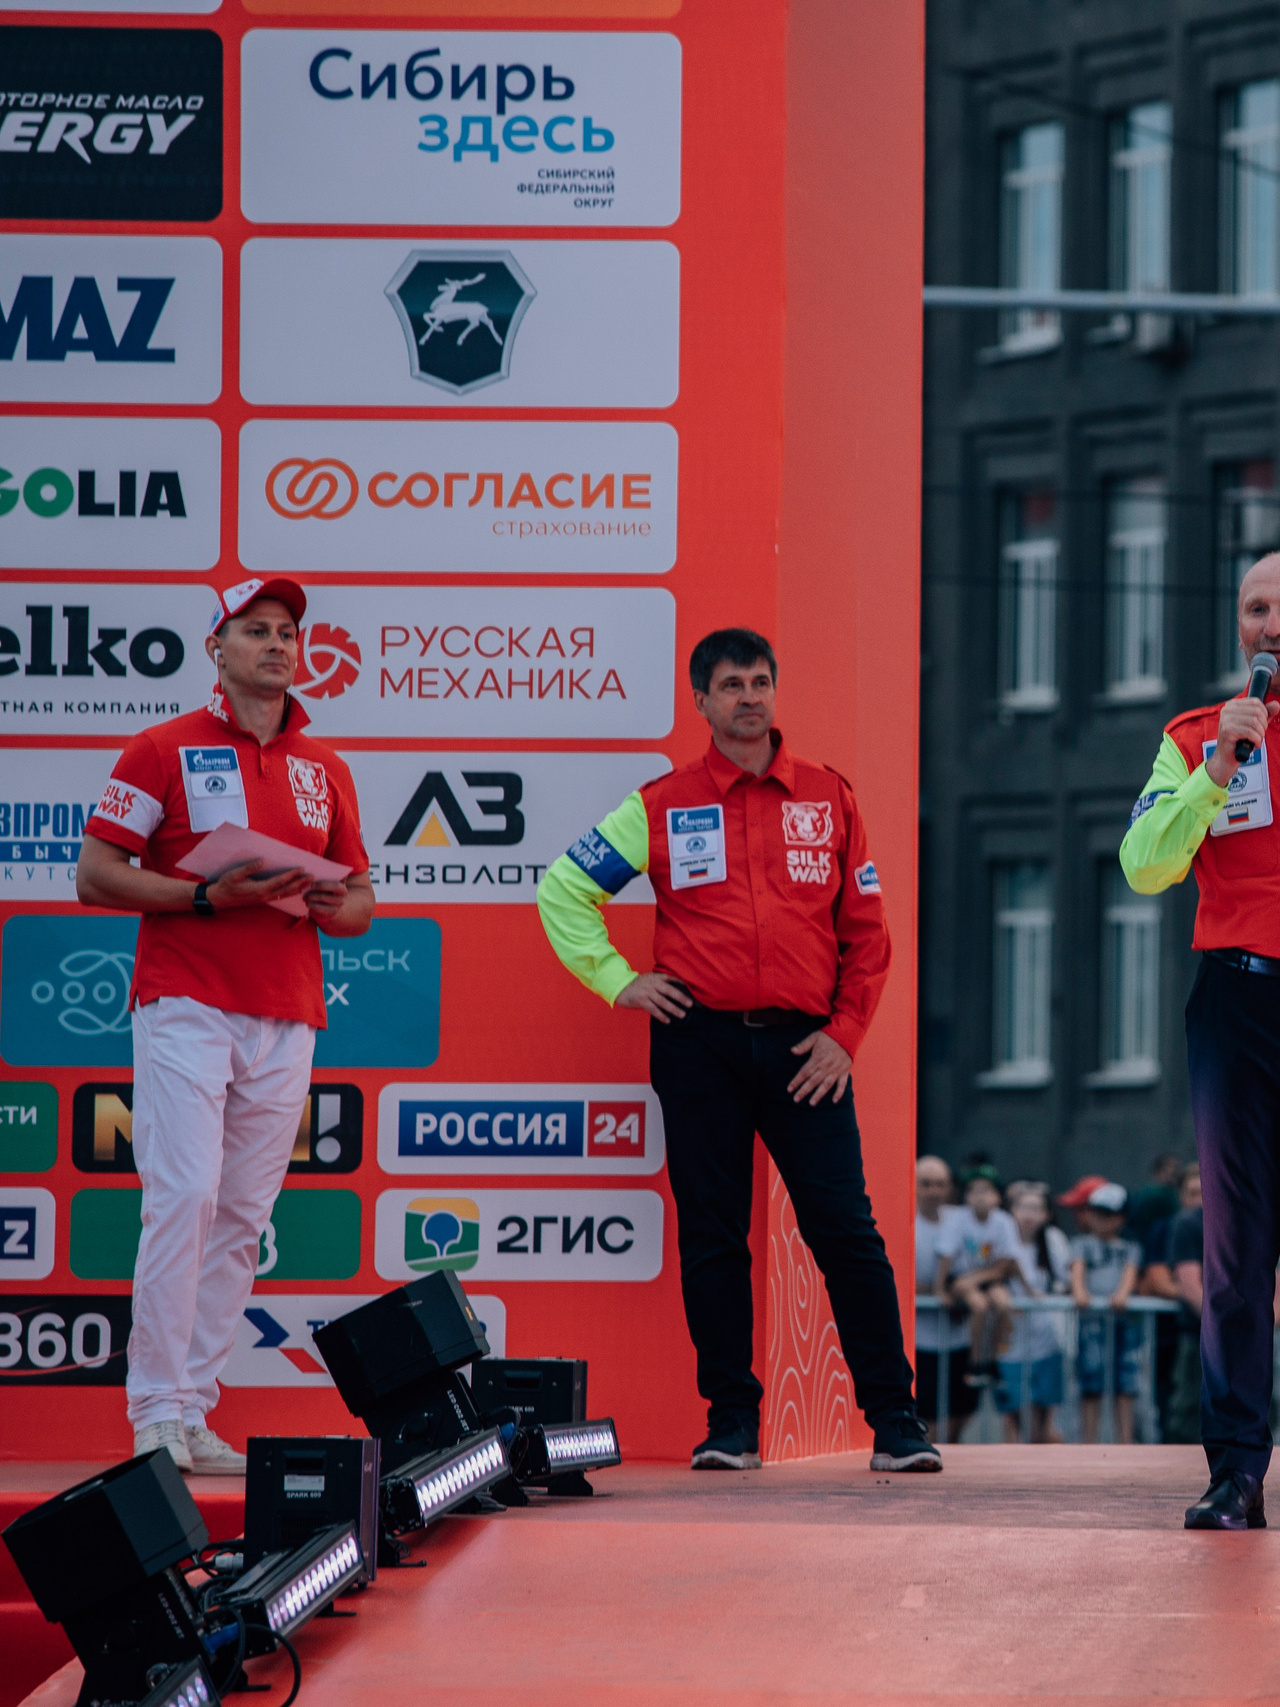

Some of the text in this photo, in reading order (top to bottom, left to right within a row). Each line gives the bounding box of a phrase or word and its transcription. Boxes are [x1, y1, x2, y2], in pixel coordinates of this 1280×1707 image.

[309, 47, 576, 115] Сибирь
[116, 95, 204, 110] МАСЛО
[0, 112, 195, 164] ERGY
[418, 113, 615, 162] здесь
[538, 166, 615, 179] СИБИРСКИЙ
[517, 181, 615, 194] ФЕДЕРАЛЬНЫЙ
[573, 198, 614, 208] ОКРУГ
[367, 472, 652, 508] СОГЛАСИЕ
[492, 520, 651, 538] страхование
[380, 625, 595, 658] РУССКАЯ
[380, 668, 626, 699] МЕХАНИКА
[64, 701, 180, 715] КОМПАНИЯ
[104, 784, 137, 807] SILK
[99, 799, 132, 820] WAY
[295, 799, 329, 819] SILK
[299, 813, 329, 833] WAY
[570, 840, 600, 870] WAY
[786, 850, 831, 869] SILK
[787, 865, 831, 885] WAY
[415, 1112, 639, 1147] РОССИЯ 24
[496, 1216, 634, 1254] 2ГИС
[286, 1491, 309, 1499] SPARK
